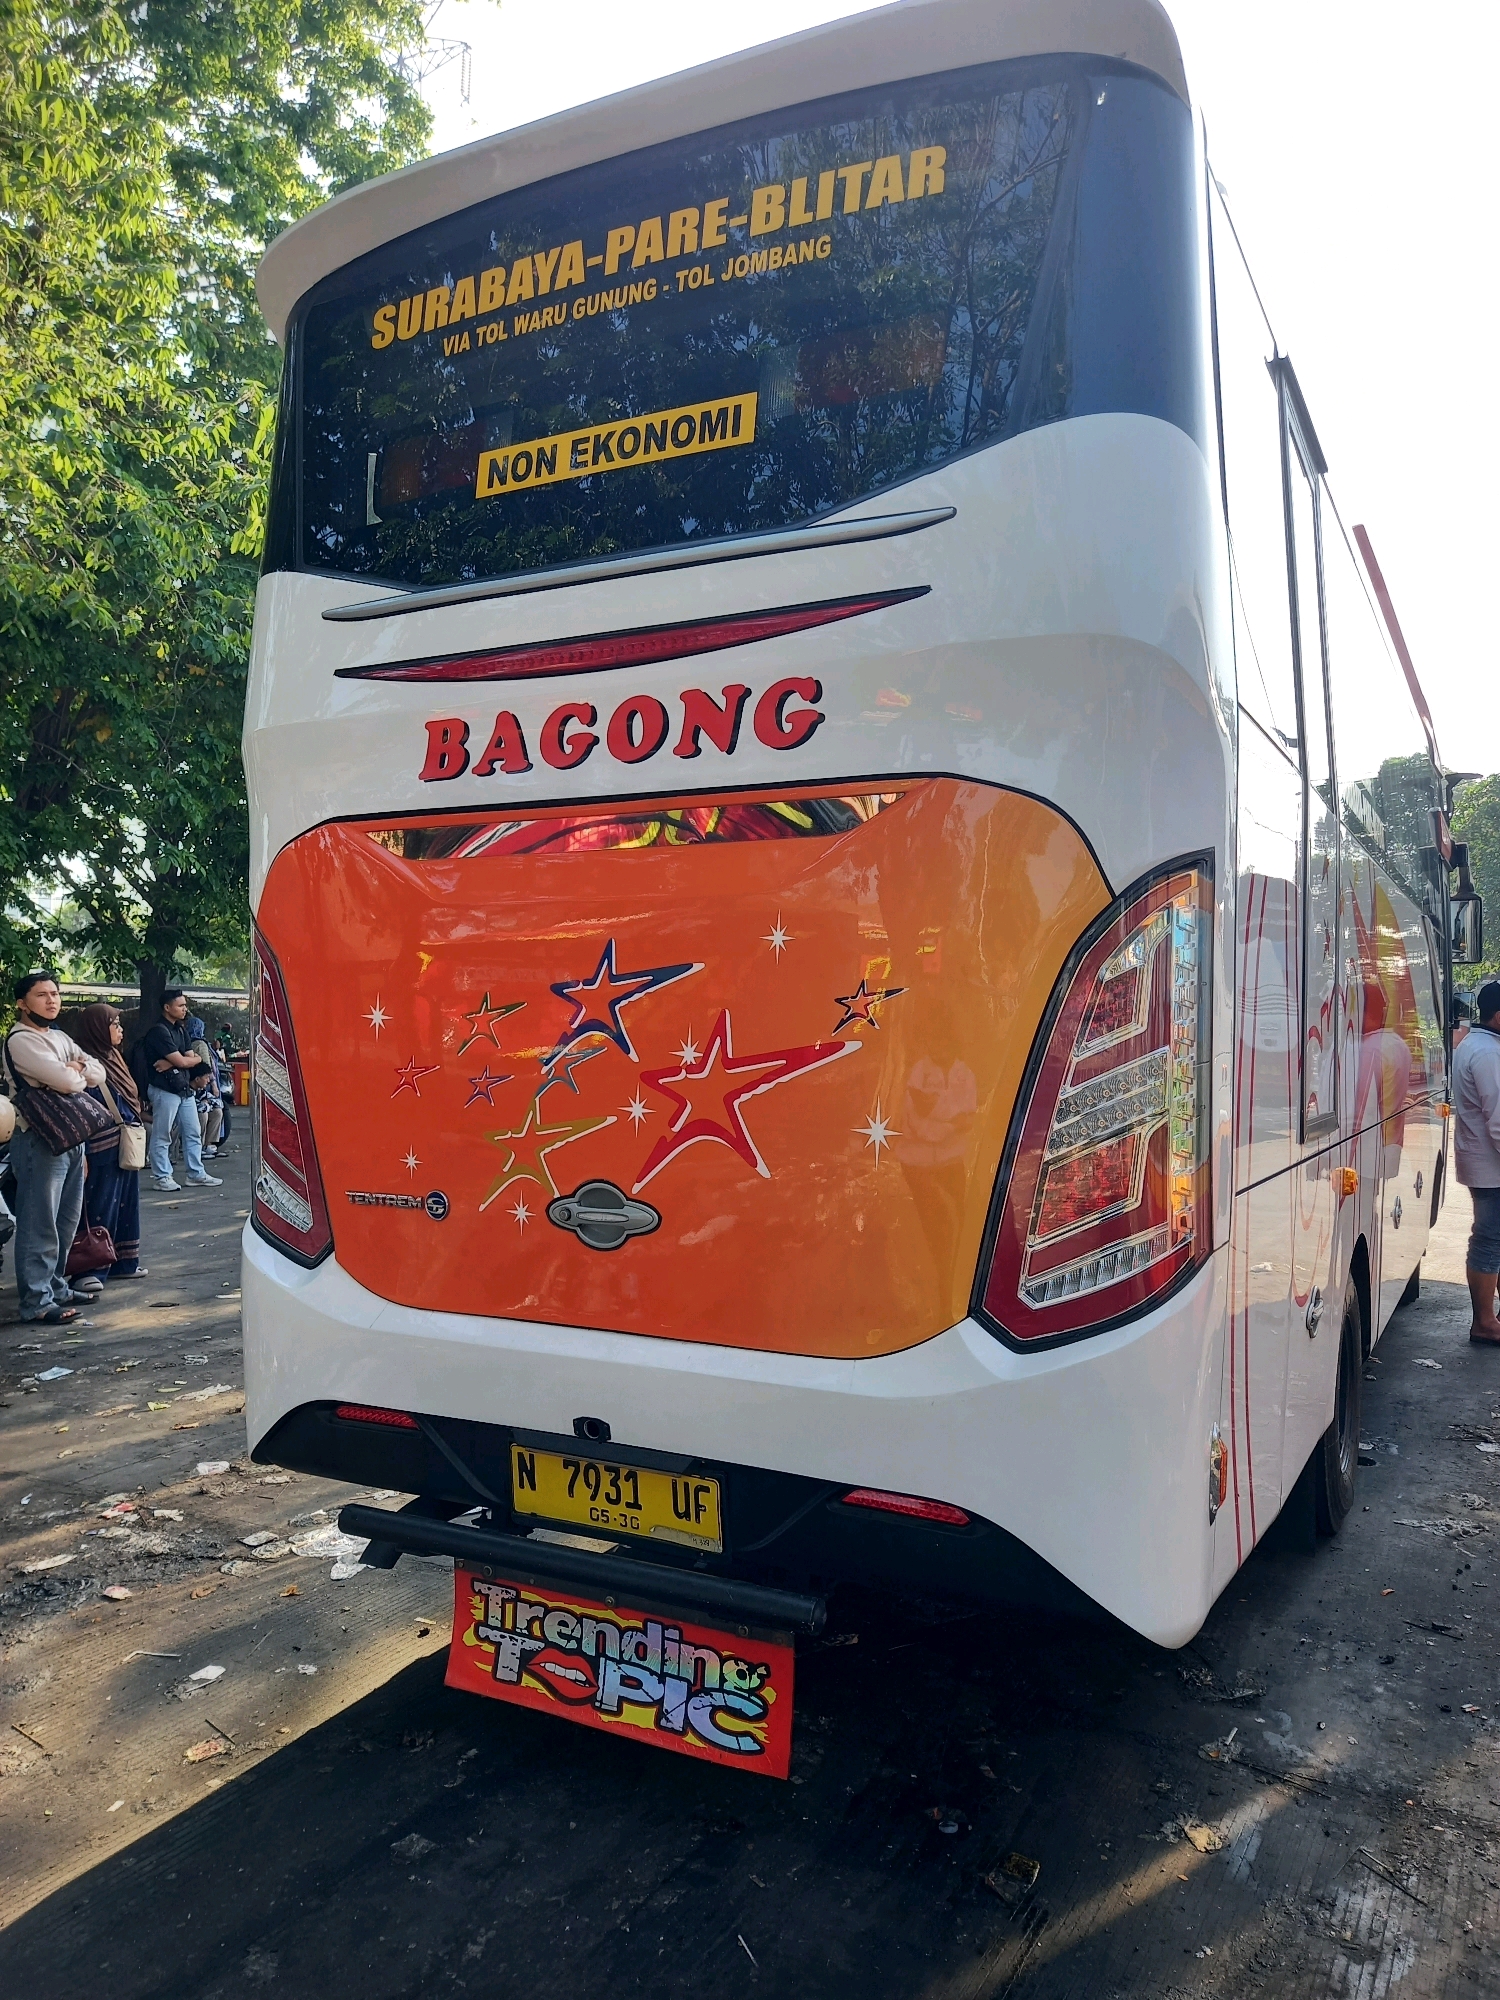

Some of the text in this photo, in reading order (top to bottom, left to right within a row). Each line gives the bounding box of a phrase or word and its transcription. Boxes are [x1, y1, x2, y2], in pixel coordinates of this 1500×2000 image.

[370, 145, 947, 350] SURABAYA-PARE-BLITAR
[443, 331, 470, 357] VIA
[476, 321, 508, 347] TOL
[514, 302, 567, 335] WARU
[573, 278, 657, 319] GUNUNG
[675, 264, 715, 293] TOL
[721, 235, 832, 282] JOMBANG
[487, 404, 742, 489] NON EKONOMI
[418, 676, 826, 782] BAGONG
[344, 1190, 424, 1209] TENTREM
[517, 1451, 711, 1524] N 7931 UF
[472, 1578, 771, 1695] Trending
